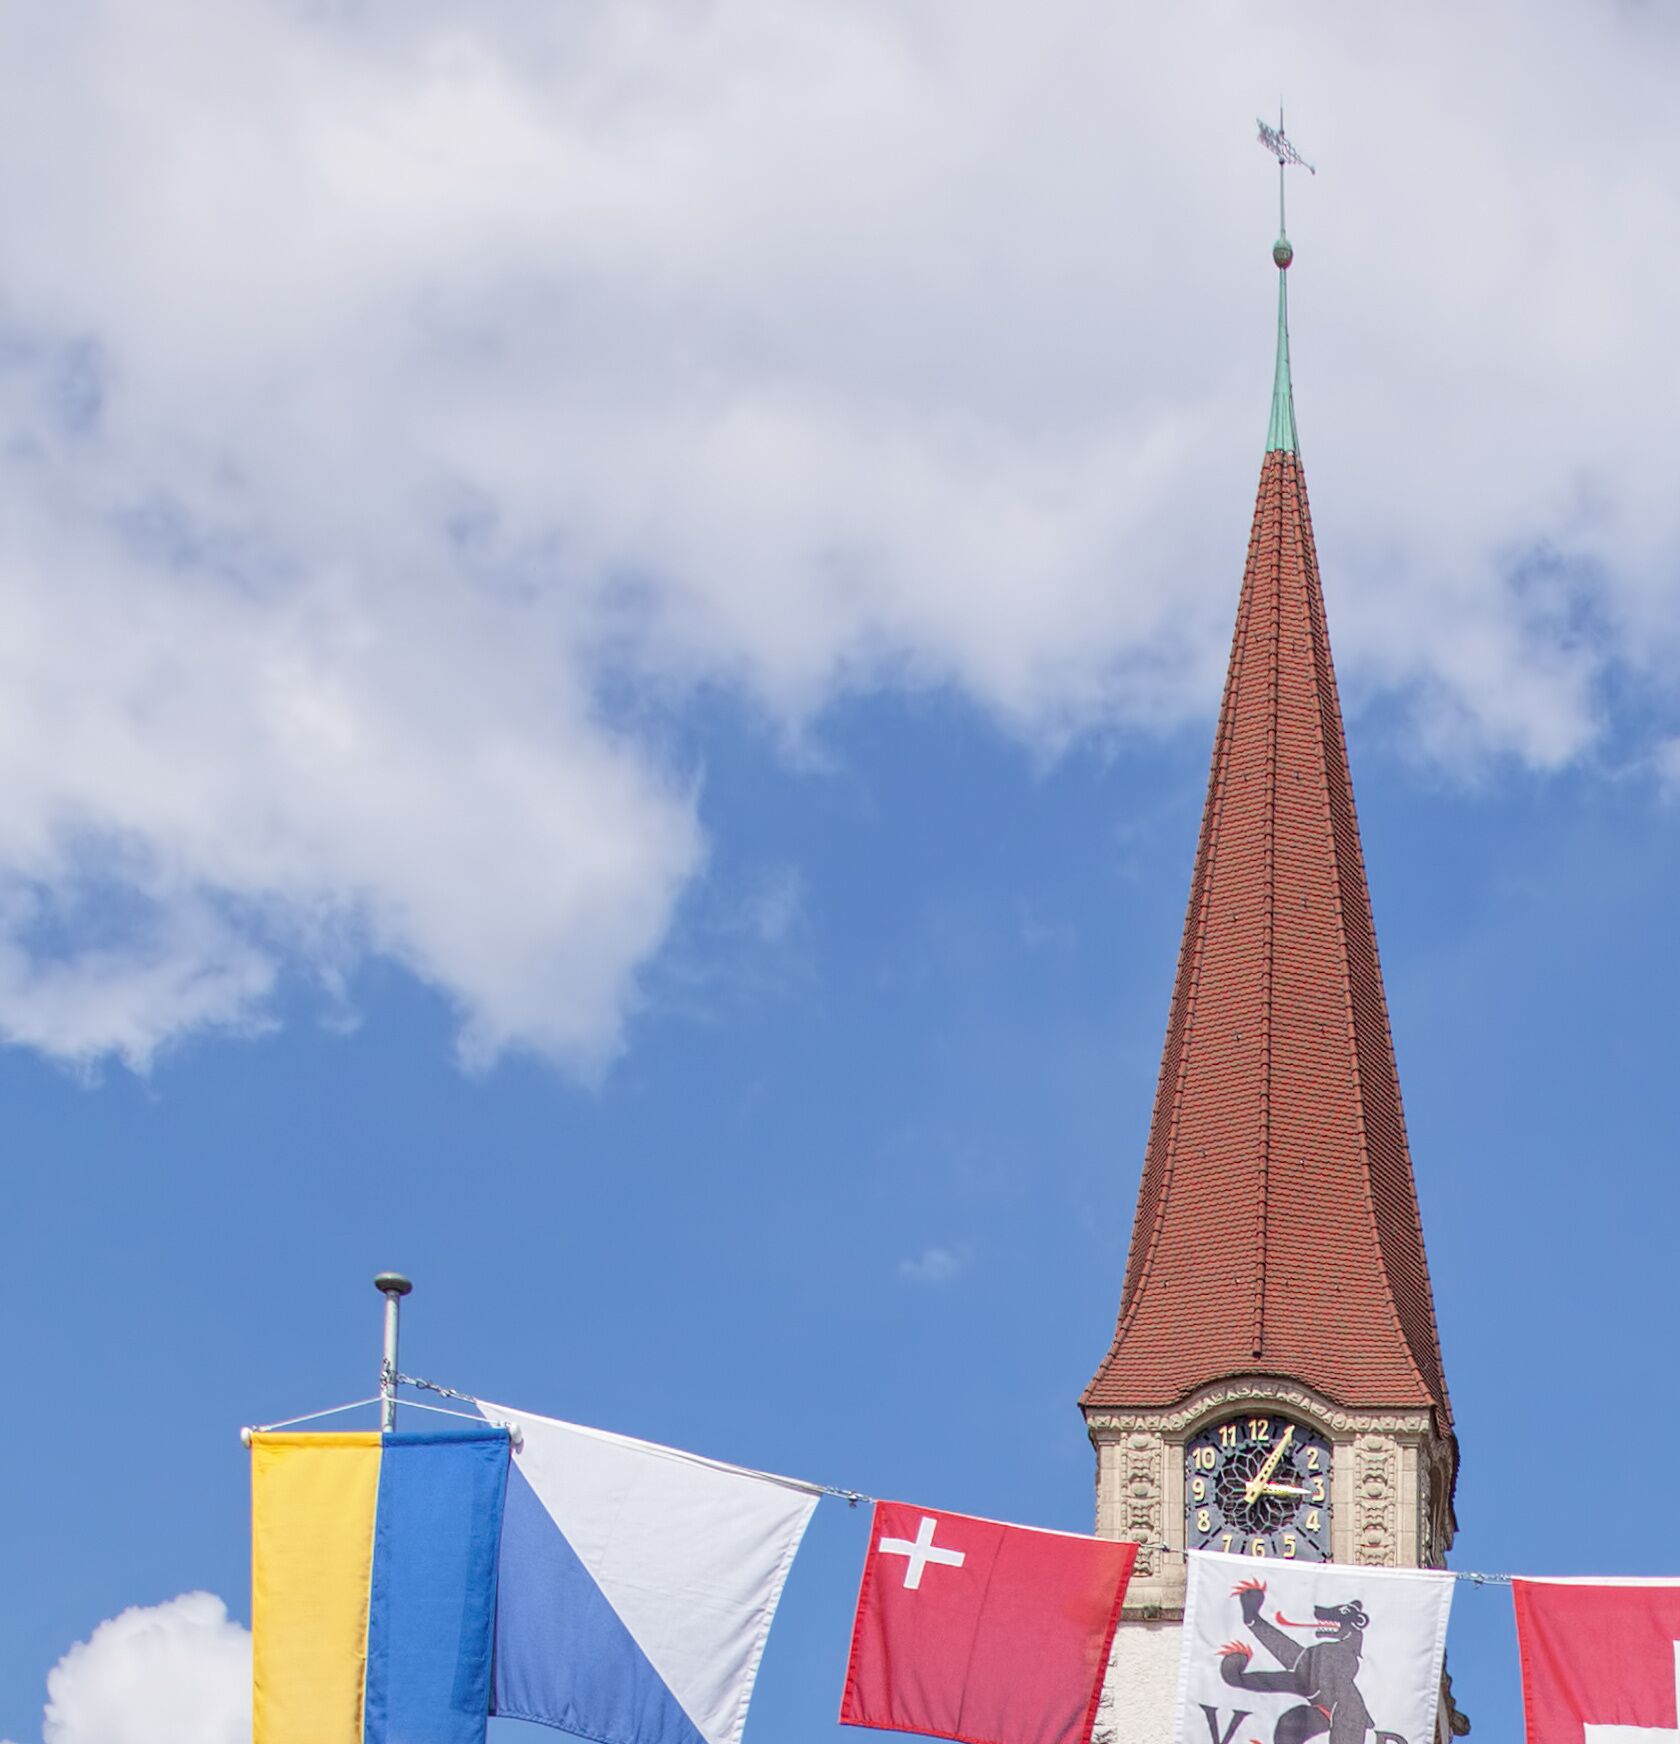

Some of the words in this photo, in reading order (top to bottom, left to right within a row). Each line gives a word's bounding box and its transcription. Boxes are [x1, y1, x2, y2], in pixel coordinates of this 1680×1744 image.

[1219, 1425, 1237, 1447] 11
[1249, 1420, 1269, 1440] 12
[1193, 1447, 1216, 1469] 10
[1307, 1447, 1320, 1470] 2
[1192, 1479, 1205, 1501] 9
[1312, 1478, 1325, 1502] 3
[1197, 1510, 1211, 1532] 8
[1306, 1510, 1321, 1532] 4
[1222, 1534, 1233, 1552] 7
[1252, 1538, 1265, 1557] 6
[1283, 1535, 1296, 1557] 5
